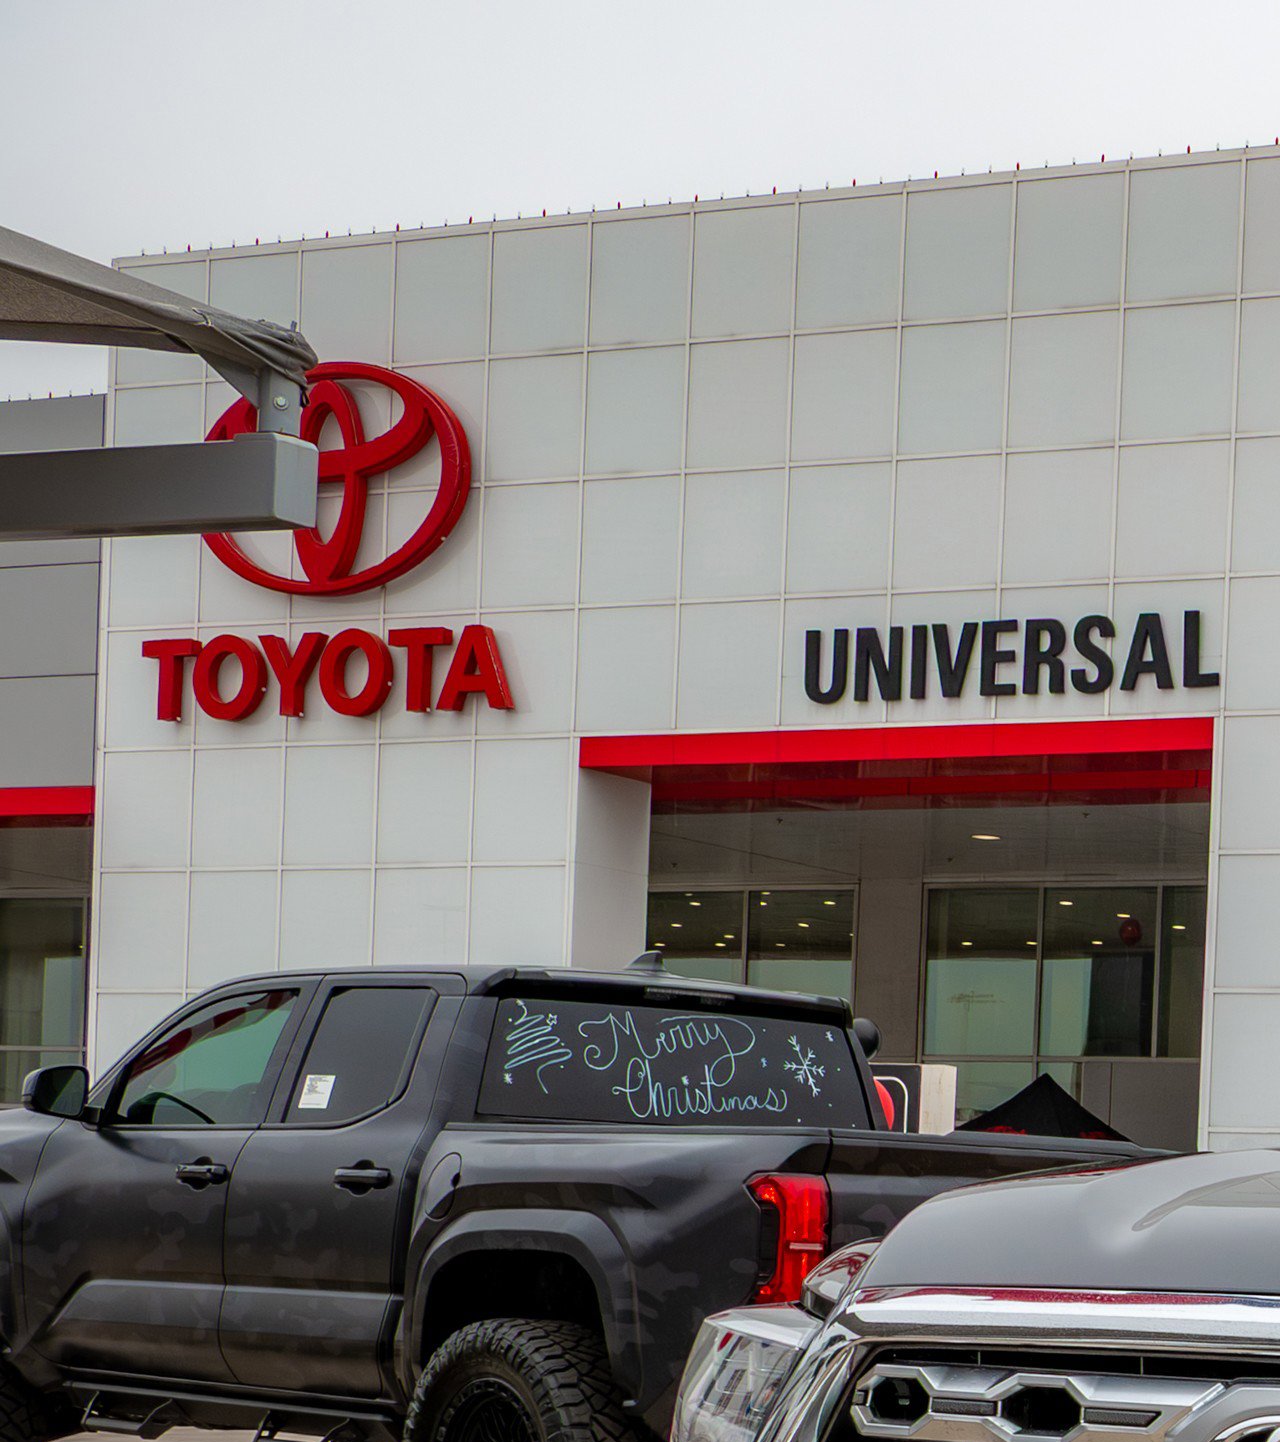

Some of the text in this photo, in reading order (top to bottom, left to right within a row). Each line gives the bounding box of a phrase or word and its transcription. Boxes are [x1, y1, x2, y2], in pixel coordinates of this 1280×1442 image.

[141, 624, 516, 723] TOYOTA
[804, 610, 1220, 704] UNIVERSAL
[578, 1010, 756, 1087] Merry
[611, 1056, 788, 1119] Christmas
